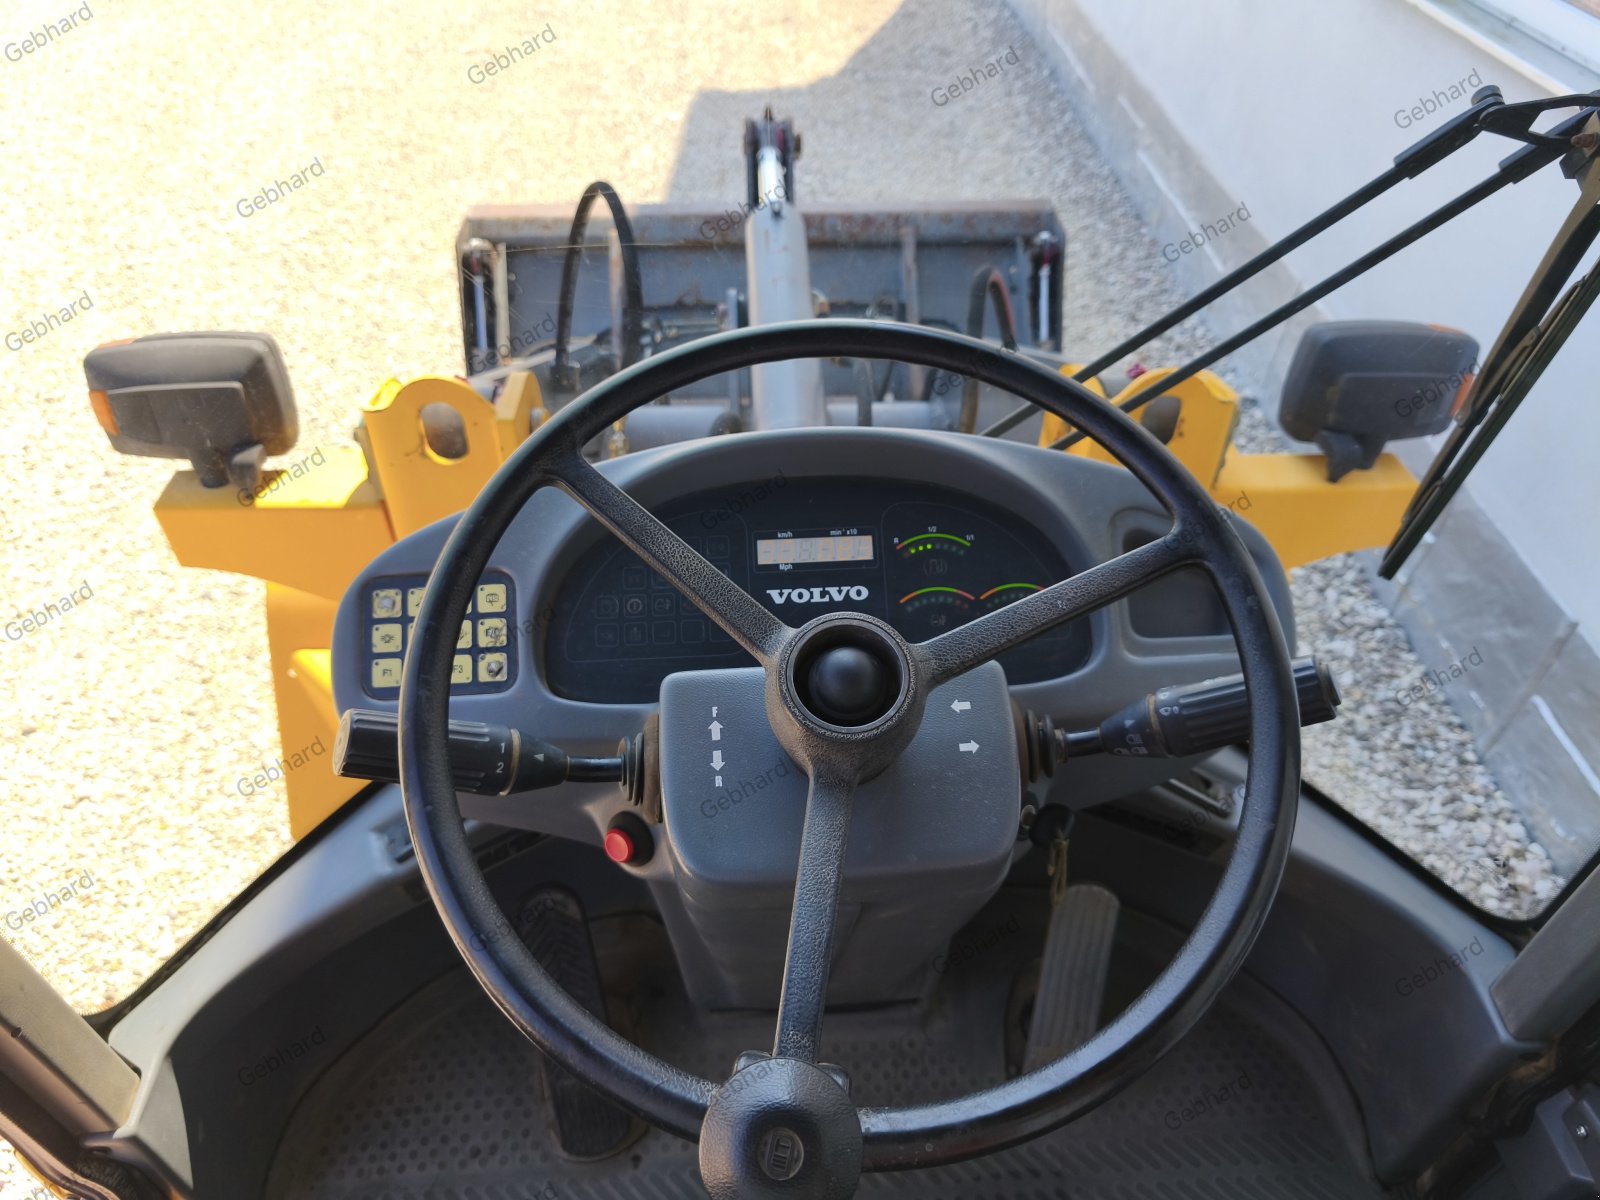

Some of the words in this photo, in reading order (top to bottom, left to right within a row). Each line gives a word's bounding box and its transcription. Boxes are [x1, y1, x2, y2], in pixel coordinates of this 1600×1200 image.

[766, 585, 869, 605] VOLVO
[382, 669, 393, 677] F1
[712, 706, 718, 717] F
[500, 743, 505, 754] 1
[496, 762, 504, 773] 2
